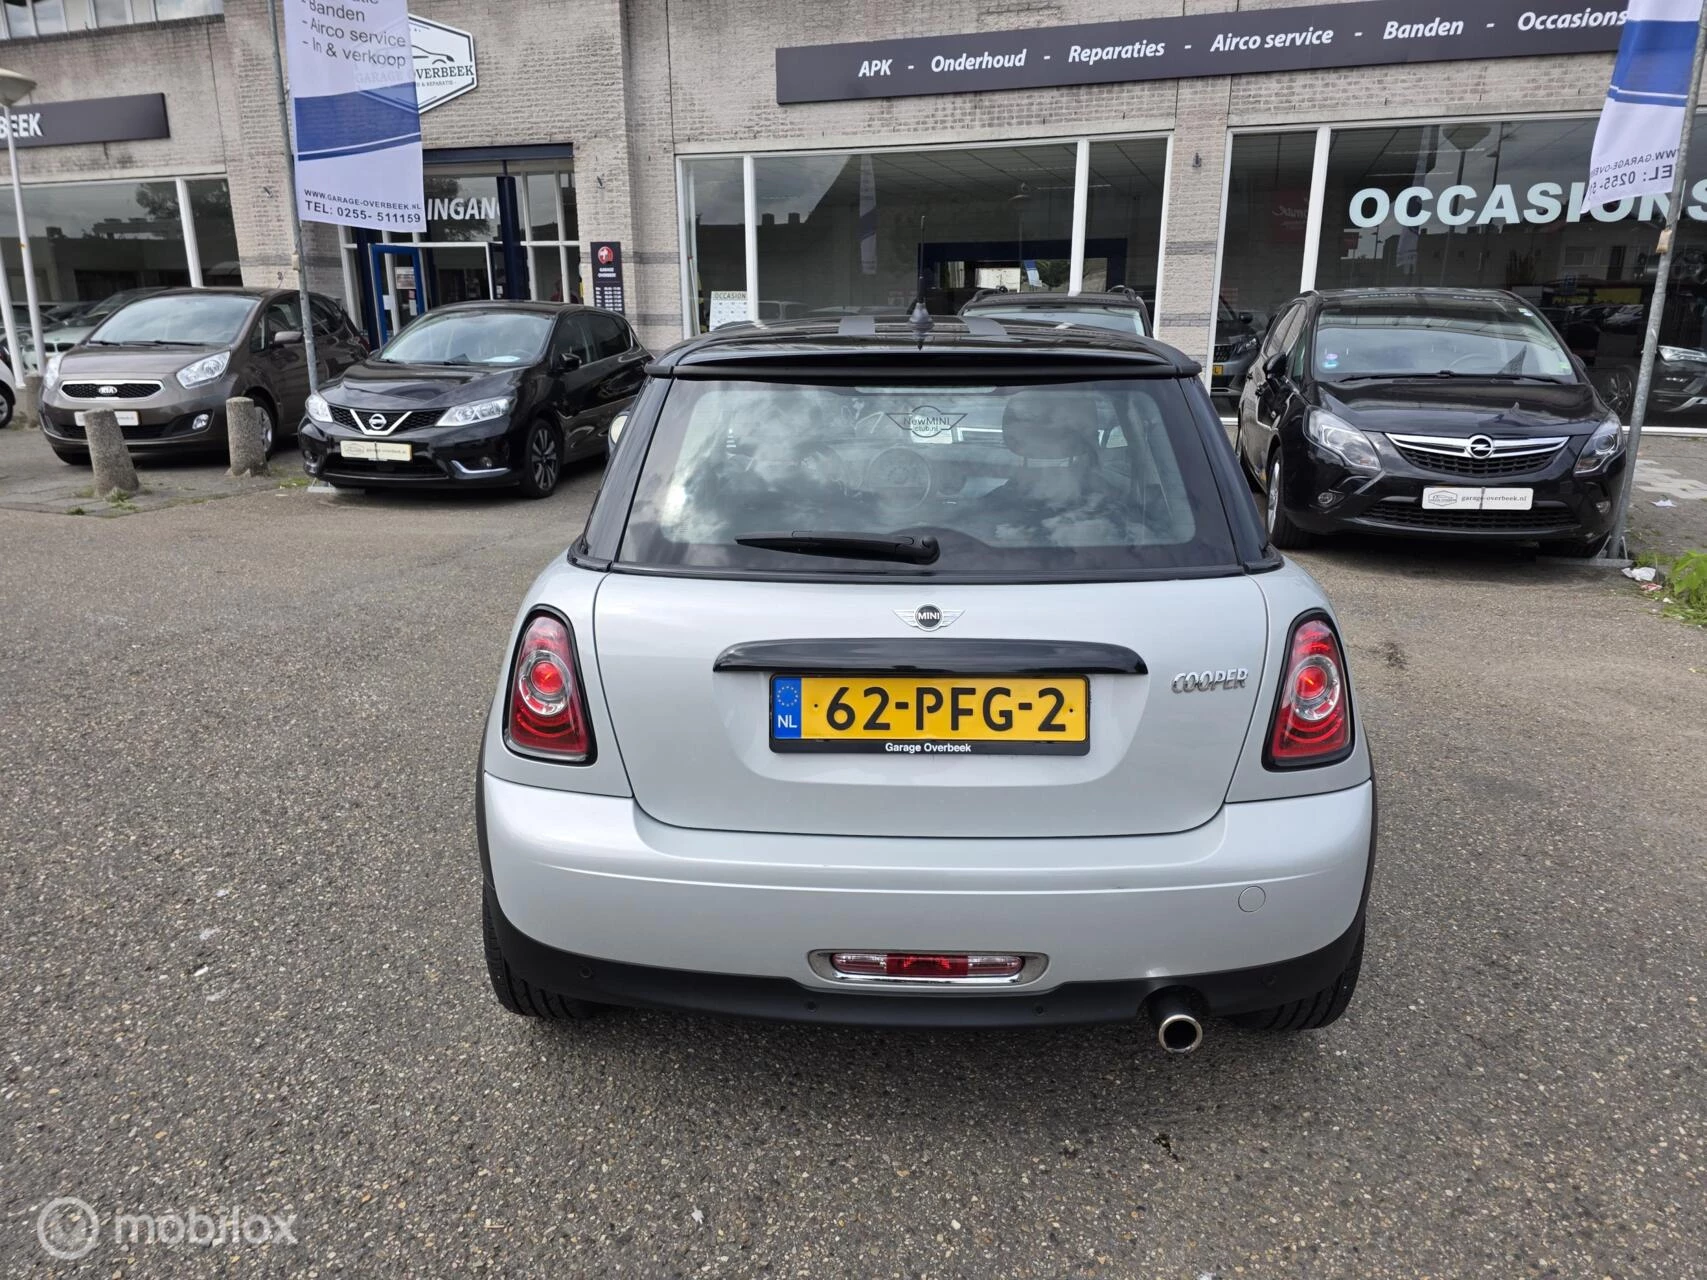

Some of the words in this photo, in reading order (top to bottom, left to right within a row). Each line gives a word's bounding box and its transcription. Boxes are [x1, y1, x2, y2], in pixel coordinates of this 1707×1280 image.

[309, 0, 365, 22] Banden
[310, 18, 345, 39] Airco
[349, 30, 406, 48] service
[858, 59, 892, 77] APK
[931, 49, 1027, 72] Onderhoud
[1068, 40, 1166, 66] Reparaties
[1209, 33, 1262, 53] Airco
[1264, 26, 1334, 48] service
[1383, 17, 1464, 40] Banden
[1517, 7, 1628, 31] Occasions
[312, 37, 322, 53] In
[326, 42, 338, 58] &
[342, 48, 406, 69] verkoop
[0, 112, 43, 139] BEEK
[304, 188, 422, 210] WWW.GARAGE-OVERBEEK.NL
[427, 197, 500, 220] INGAN
[304, 200, 333, 215] TEL:
[337, 206, 372, 220] 0255-
[377, 212, 421, 224] 511159
[101, 386, 116, 395] KIA
[903, 416, 950, 425] NewMINI
[918, 611, 940, 620] MINI
[1171, 668, 1249, 695] COOPER
[777, 715, 797, 729] NL
[826, 686, 1067, 732] 62-PFG-2
[885, 742, 921, 754] Garage
[924, 742, 972, 752] Overbeek
